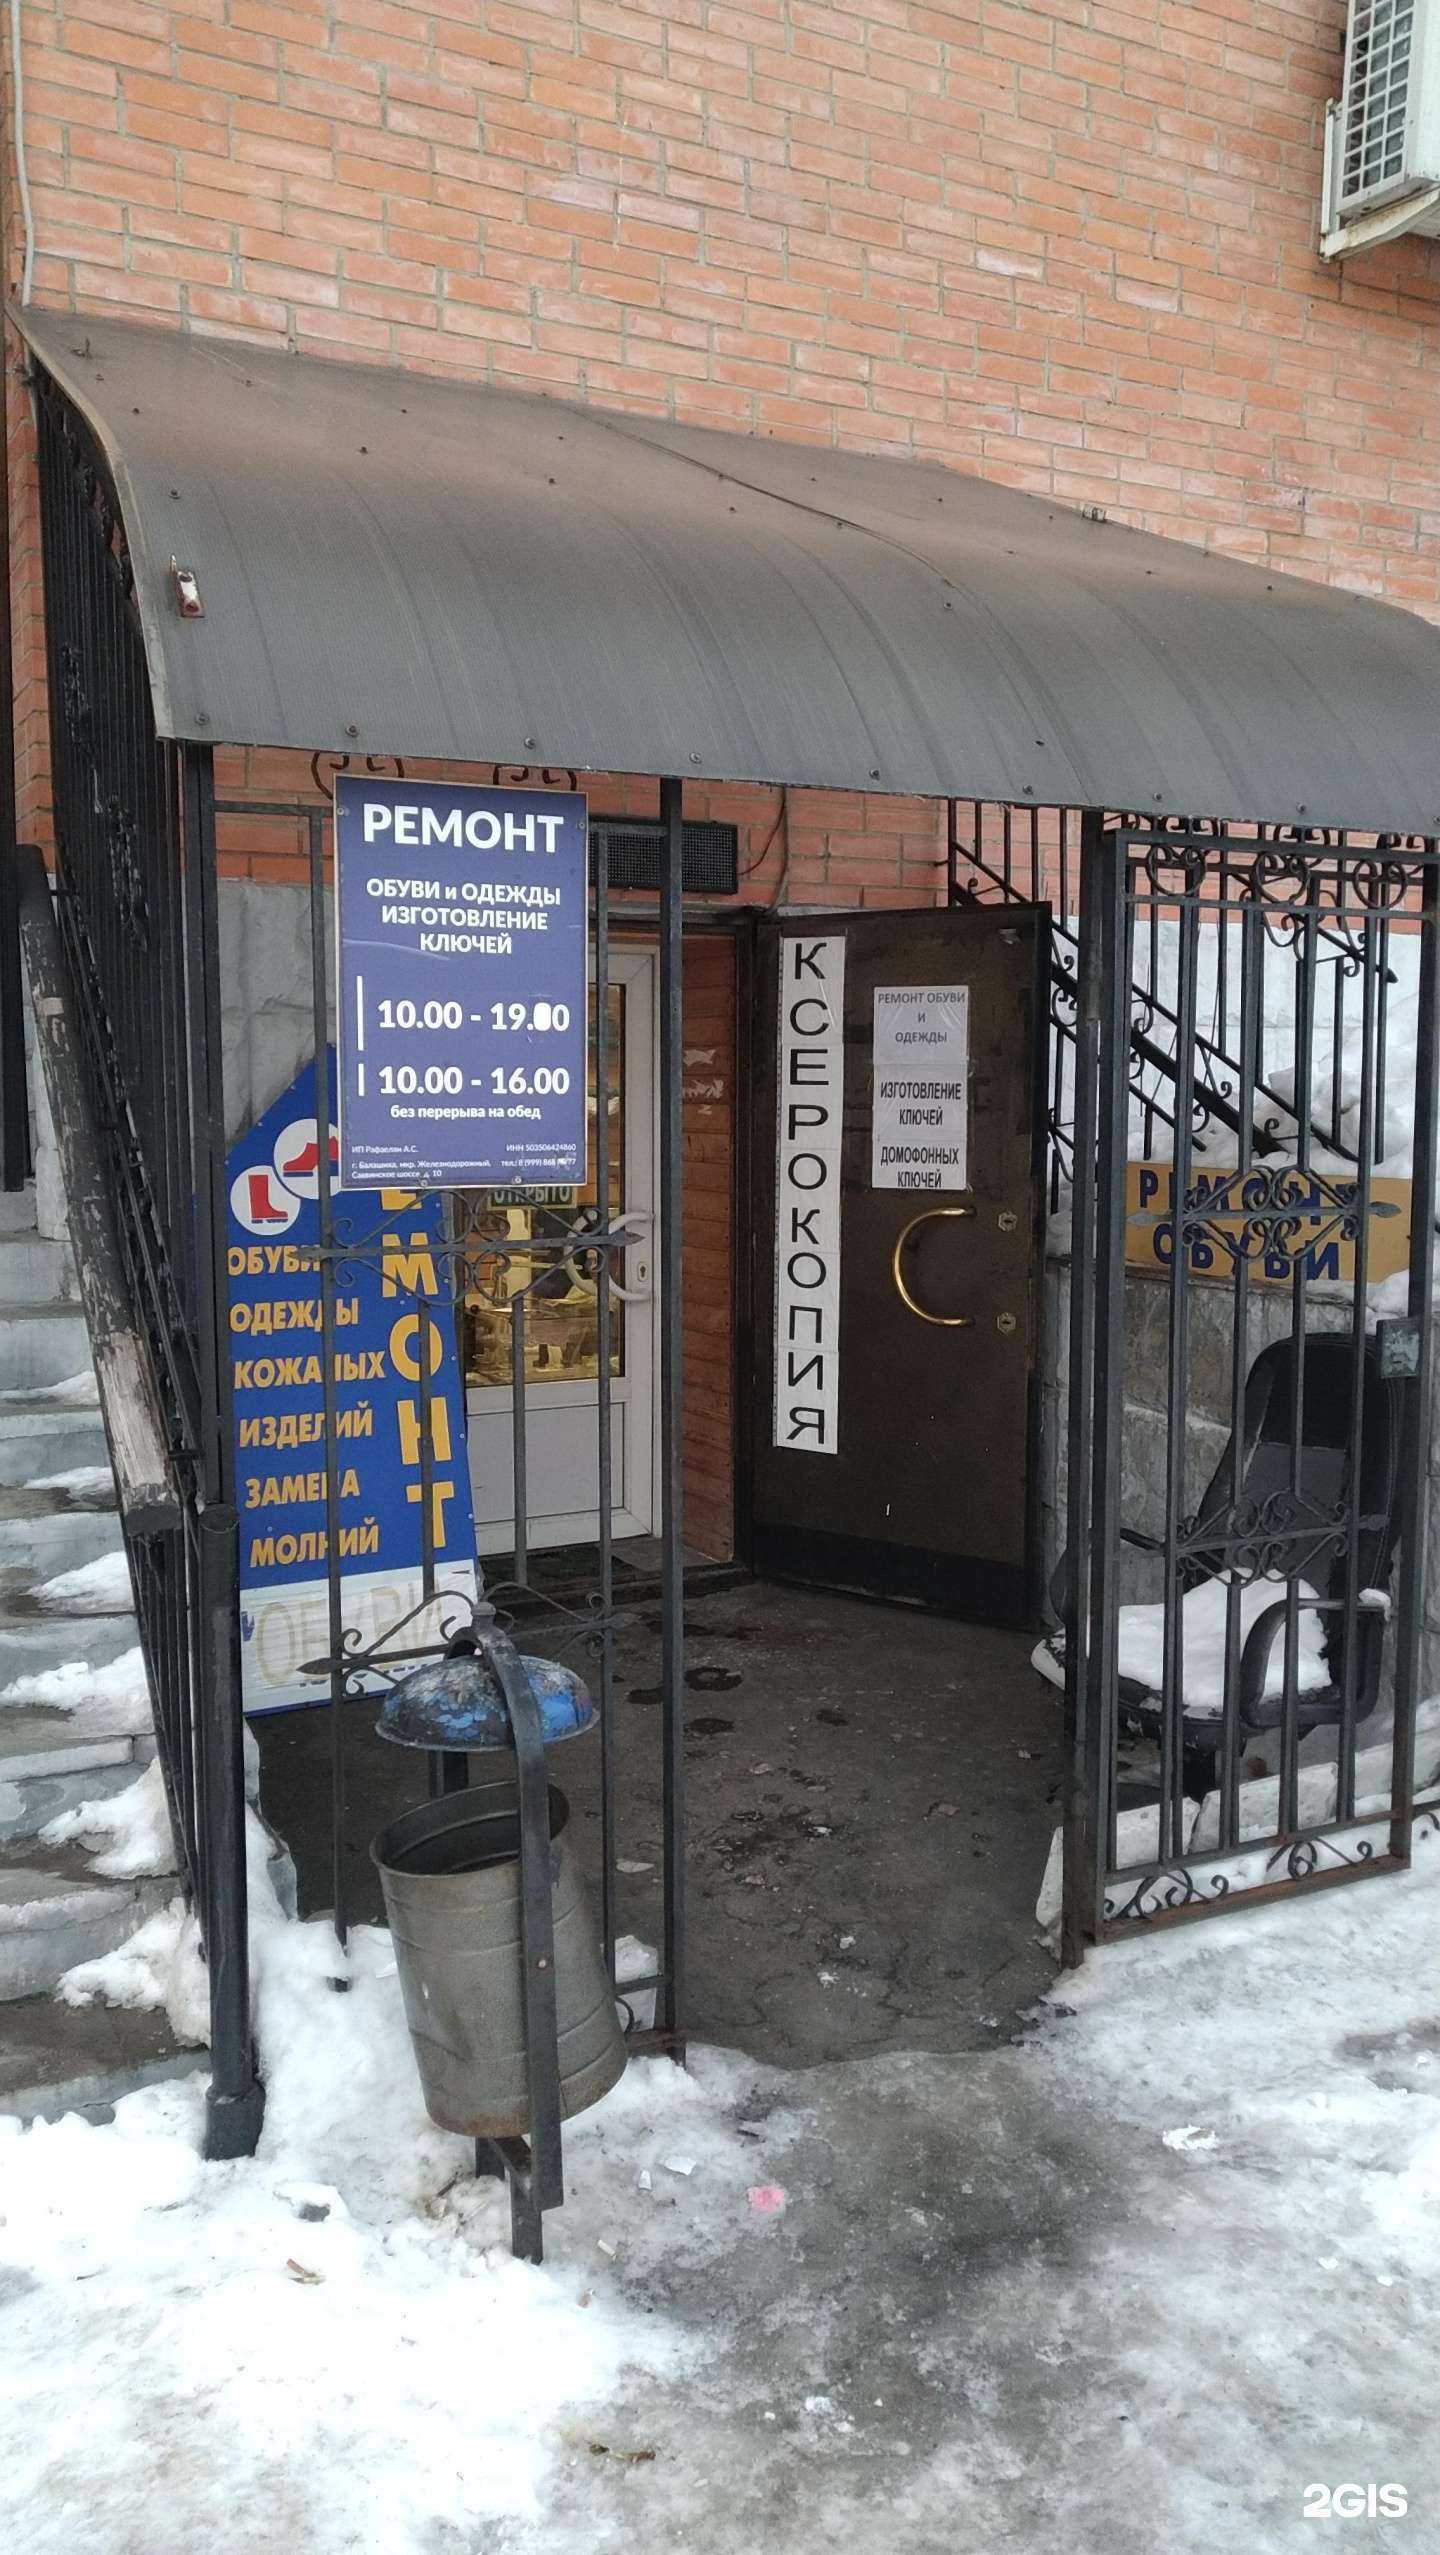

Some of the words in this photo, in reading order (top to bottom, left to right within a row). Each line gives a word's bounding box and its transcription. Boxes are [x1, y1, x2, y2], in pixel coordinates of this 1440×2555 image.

[363, 803, 564, 853] РЕМОНТ
[366, 877, 440, 900] ОБУВИ
[445, 886, 457, 900] и
[461, 882, 561, 907] ОДЕЖДЫ
[382, 905, 548, 930] ИЗГОТОВЛЕНИЕ
[420, 932, 512, 954] КЛЮЧЕЙ
[878, 992, 924, 1004] РЕМОНТ
[927, 991, 965, 1004] ОБУВИ
[378, 1000, 463, 1029] 10.00
[918, 1012, 926, 1023] И
[895, 1031, 947, 1044] ОДЕЖДЫ
[379, 1066, 463, 1094] 10.00
[491, 1067, 570, 1094] 16.00
[880, 1081, 962, 1100] ИЗГОТОВЛЕНИЕ
[390, 1104, 416, 1118] без
[418, 1106, 485, 1120] перерыва
[488, 1108, 505, 1118] на
[507, 1105, 542, 1120] обед
[899, 1107, 943, 1126] КЛЮЧЕЙ
[506, 1143, 524, 1152] ИНН
[880, 1146, 959, 1166] ДОМОФОННЫХ
[897, 1168, 942, 1188] КЛЮЧЕЙ
[786, 942, 829, 1447] КСЕРОКОПИЯ
